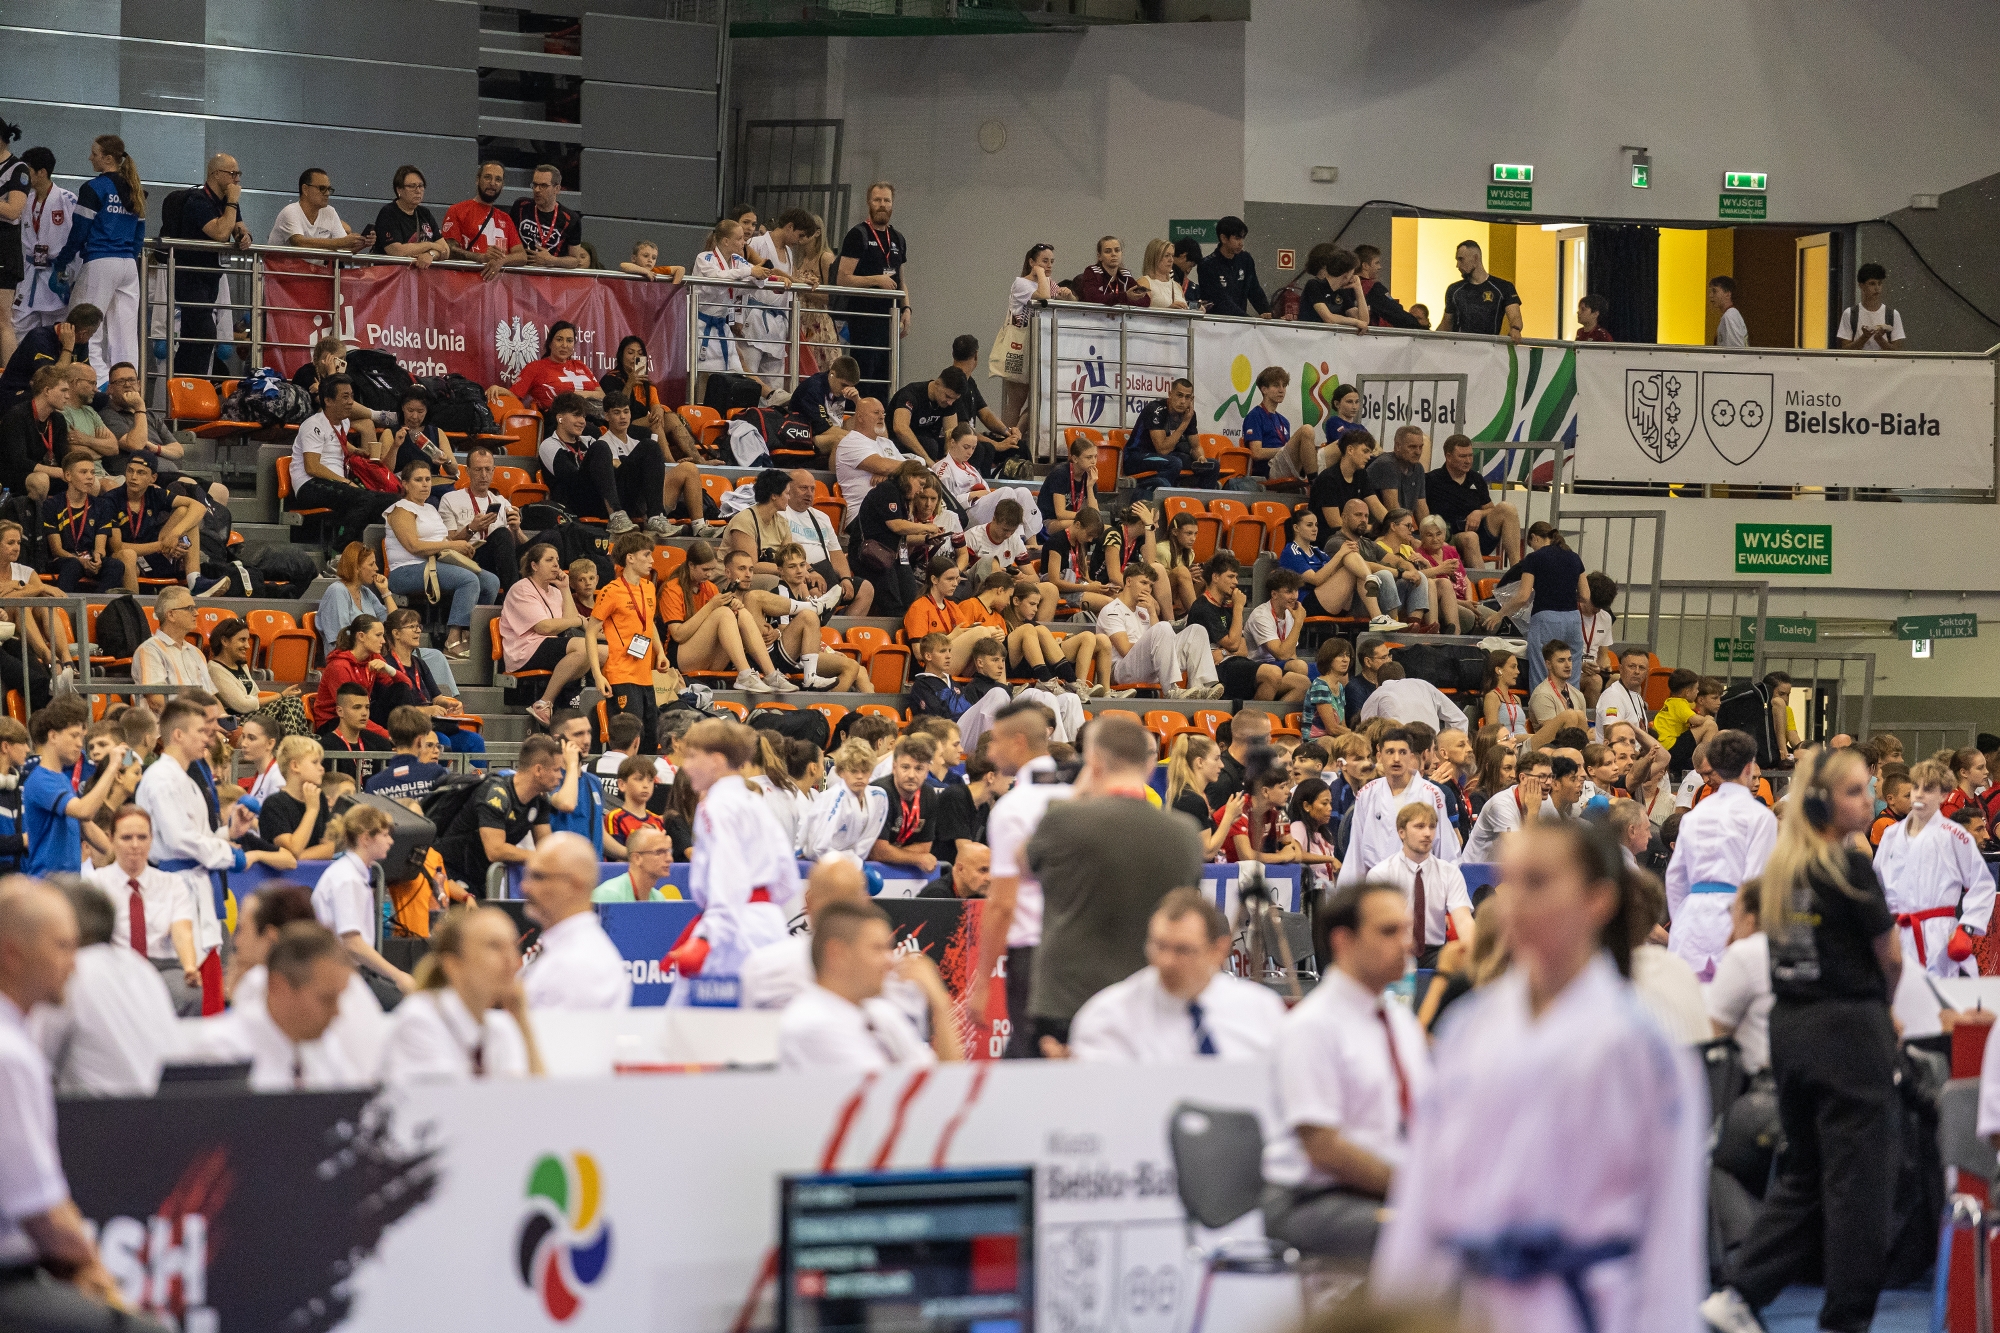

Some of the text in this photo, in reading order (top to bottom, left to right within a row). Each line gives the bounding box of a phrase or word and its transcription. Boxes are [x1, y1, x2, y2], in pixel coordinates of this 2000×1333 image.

[1490, 189, 1529, 199] WYJŚCIE
[1722, 197, 1763, 207] WYJŚCIE
[1176, 226, 1207, 236] Toalety
[366, 323, 465, 351] Polska Unia
[395, 353, 448, 378] arate
[1114, 373, 1175, 393] Polska Uni
[1785, 390, 1842, 407] Miasto
[1785, 410, 1941, 437] Bielsko-Biała
[1742, 529, 1825, 549] WYJŚCIE
[1738, 553, 1829, 566] EWAKUACYJNE
[1938, 618, 1973, 627] Sektory
[1778, 624, 1813, 637] Toalety
[1929, 627, 1974, 638] I,II,III,IX,X
